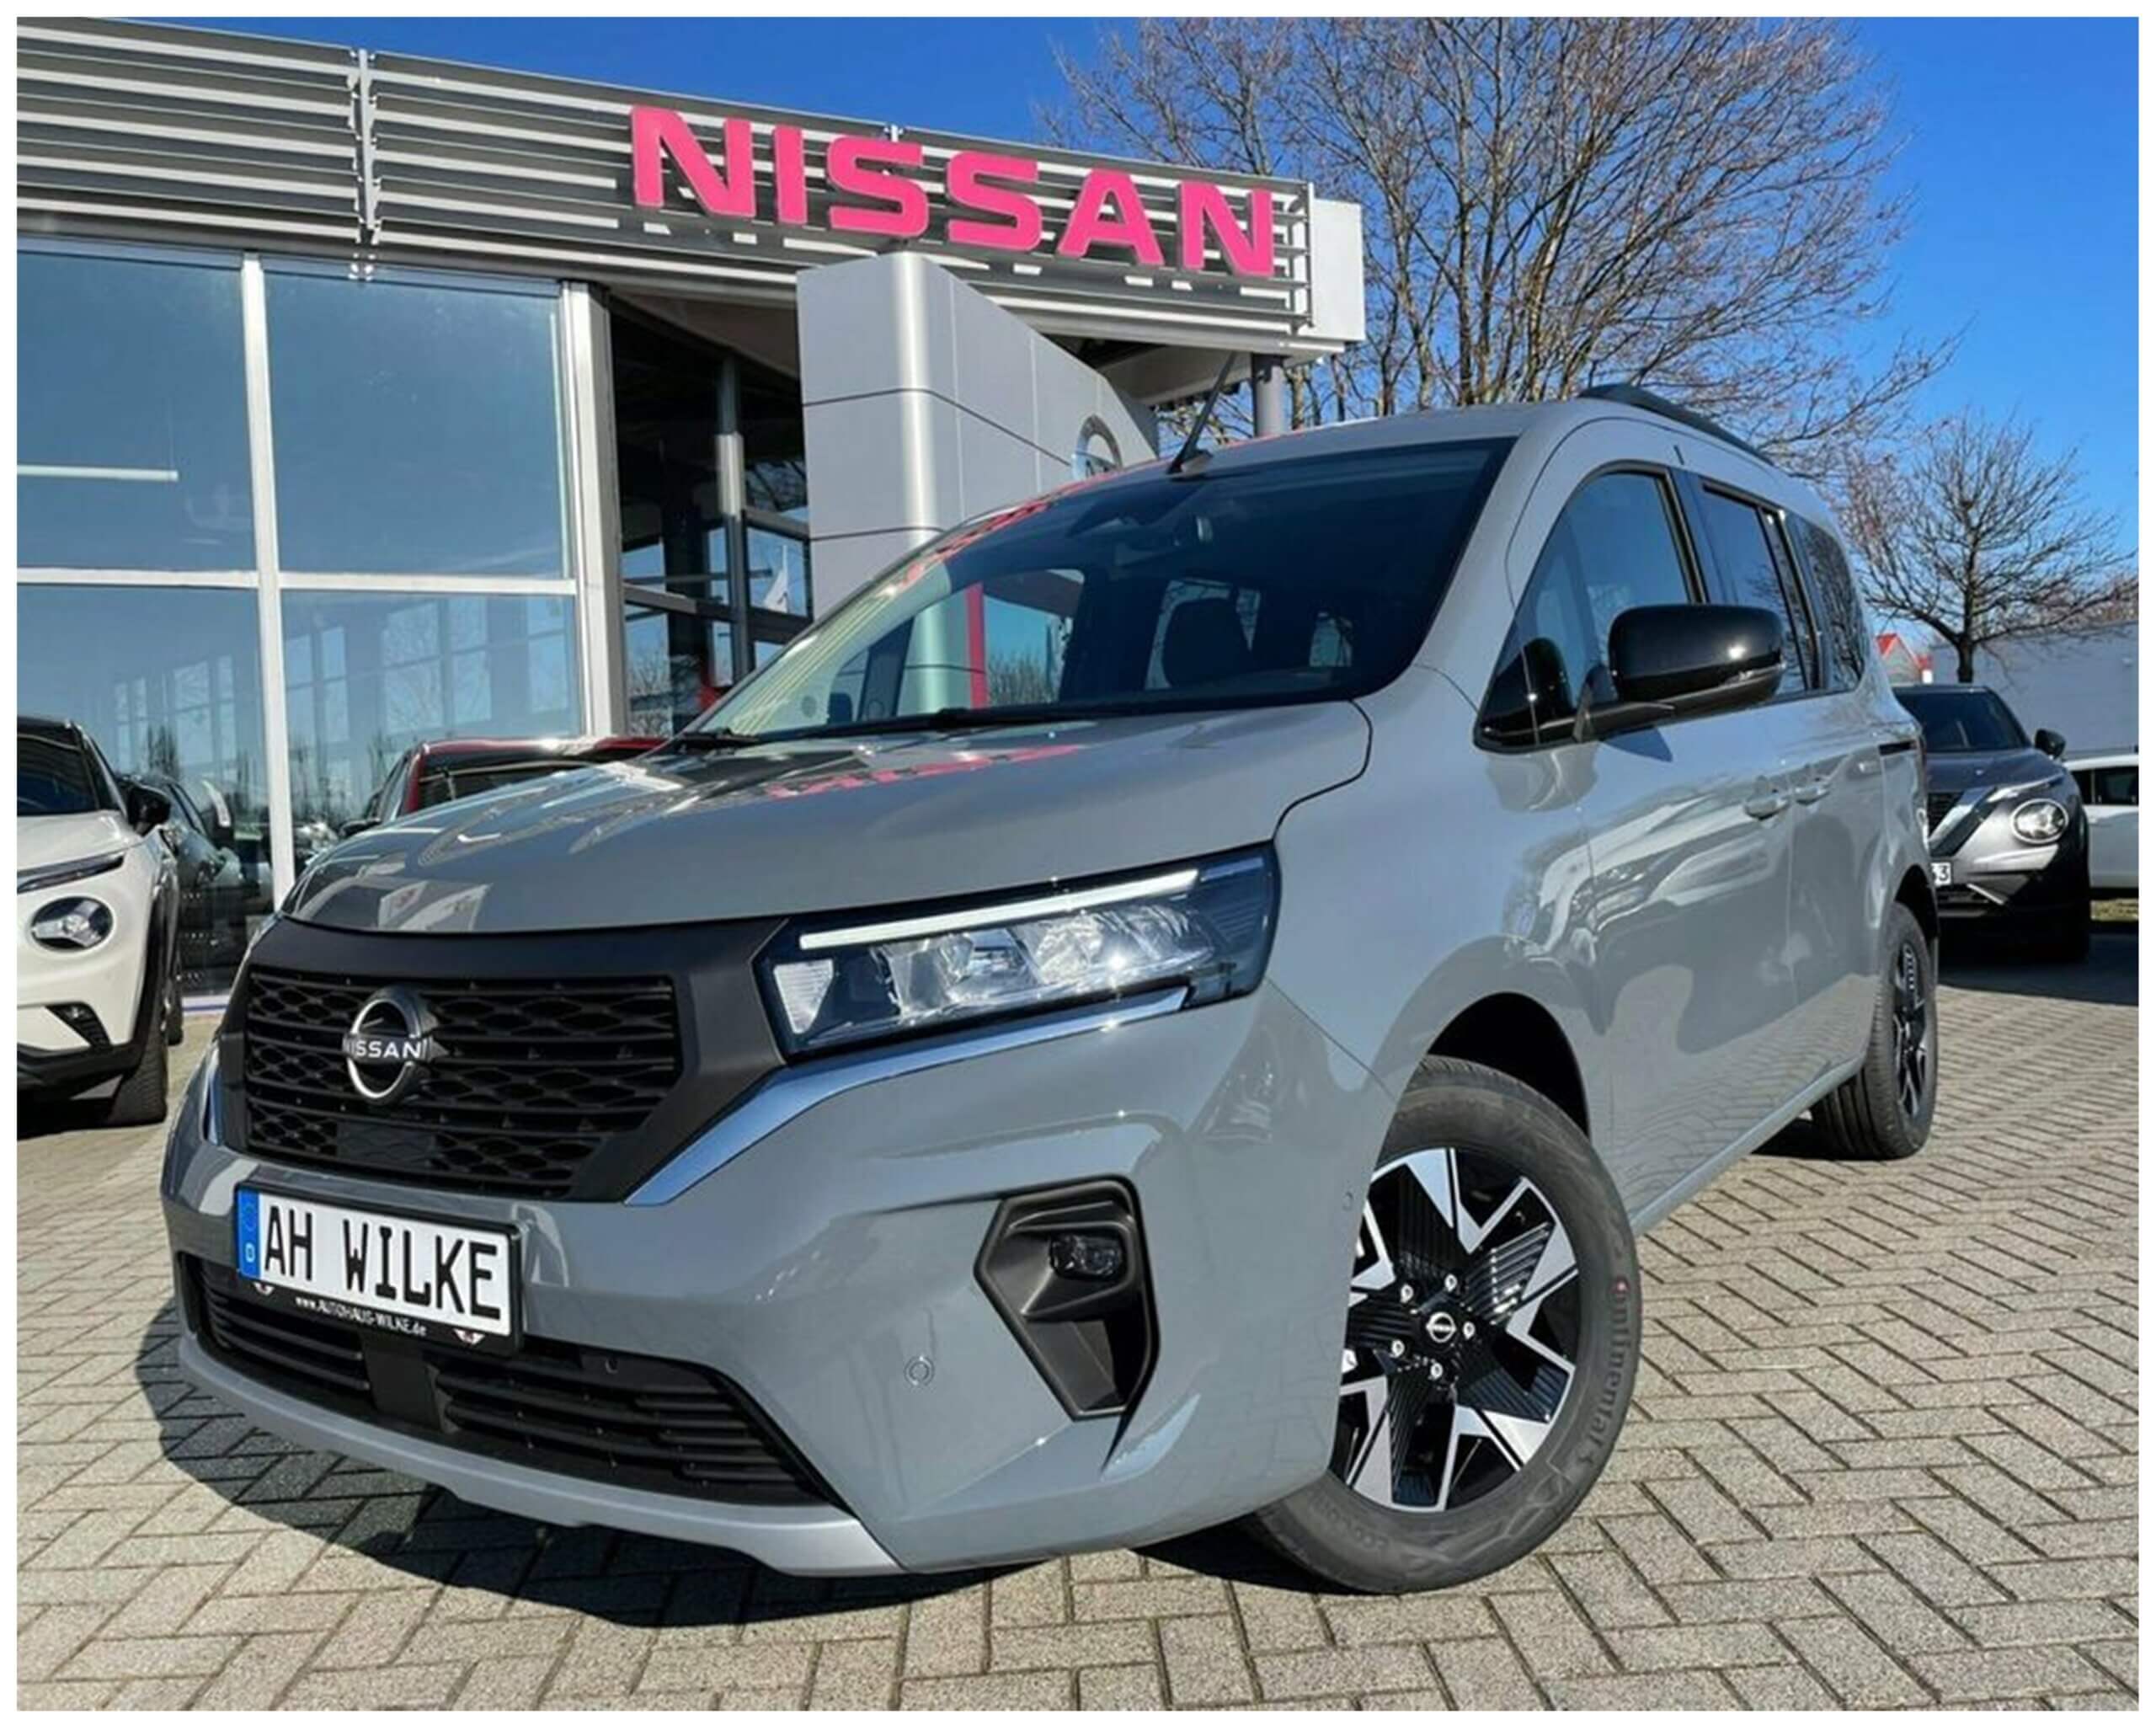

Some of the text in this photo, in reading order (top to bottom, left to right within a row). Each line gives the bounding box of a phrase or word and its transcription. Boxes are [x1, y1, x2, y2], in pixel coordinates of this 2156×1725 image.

[630, 104, 1275, 277] NISSAN
[342, 1039, 423, 1060] NISSAN
[264, 1205, 503, 1321] AH WILKE
[295, 1296, 428, 1338] www.AUTOHAUS-WILKE.de
